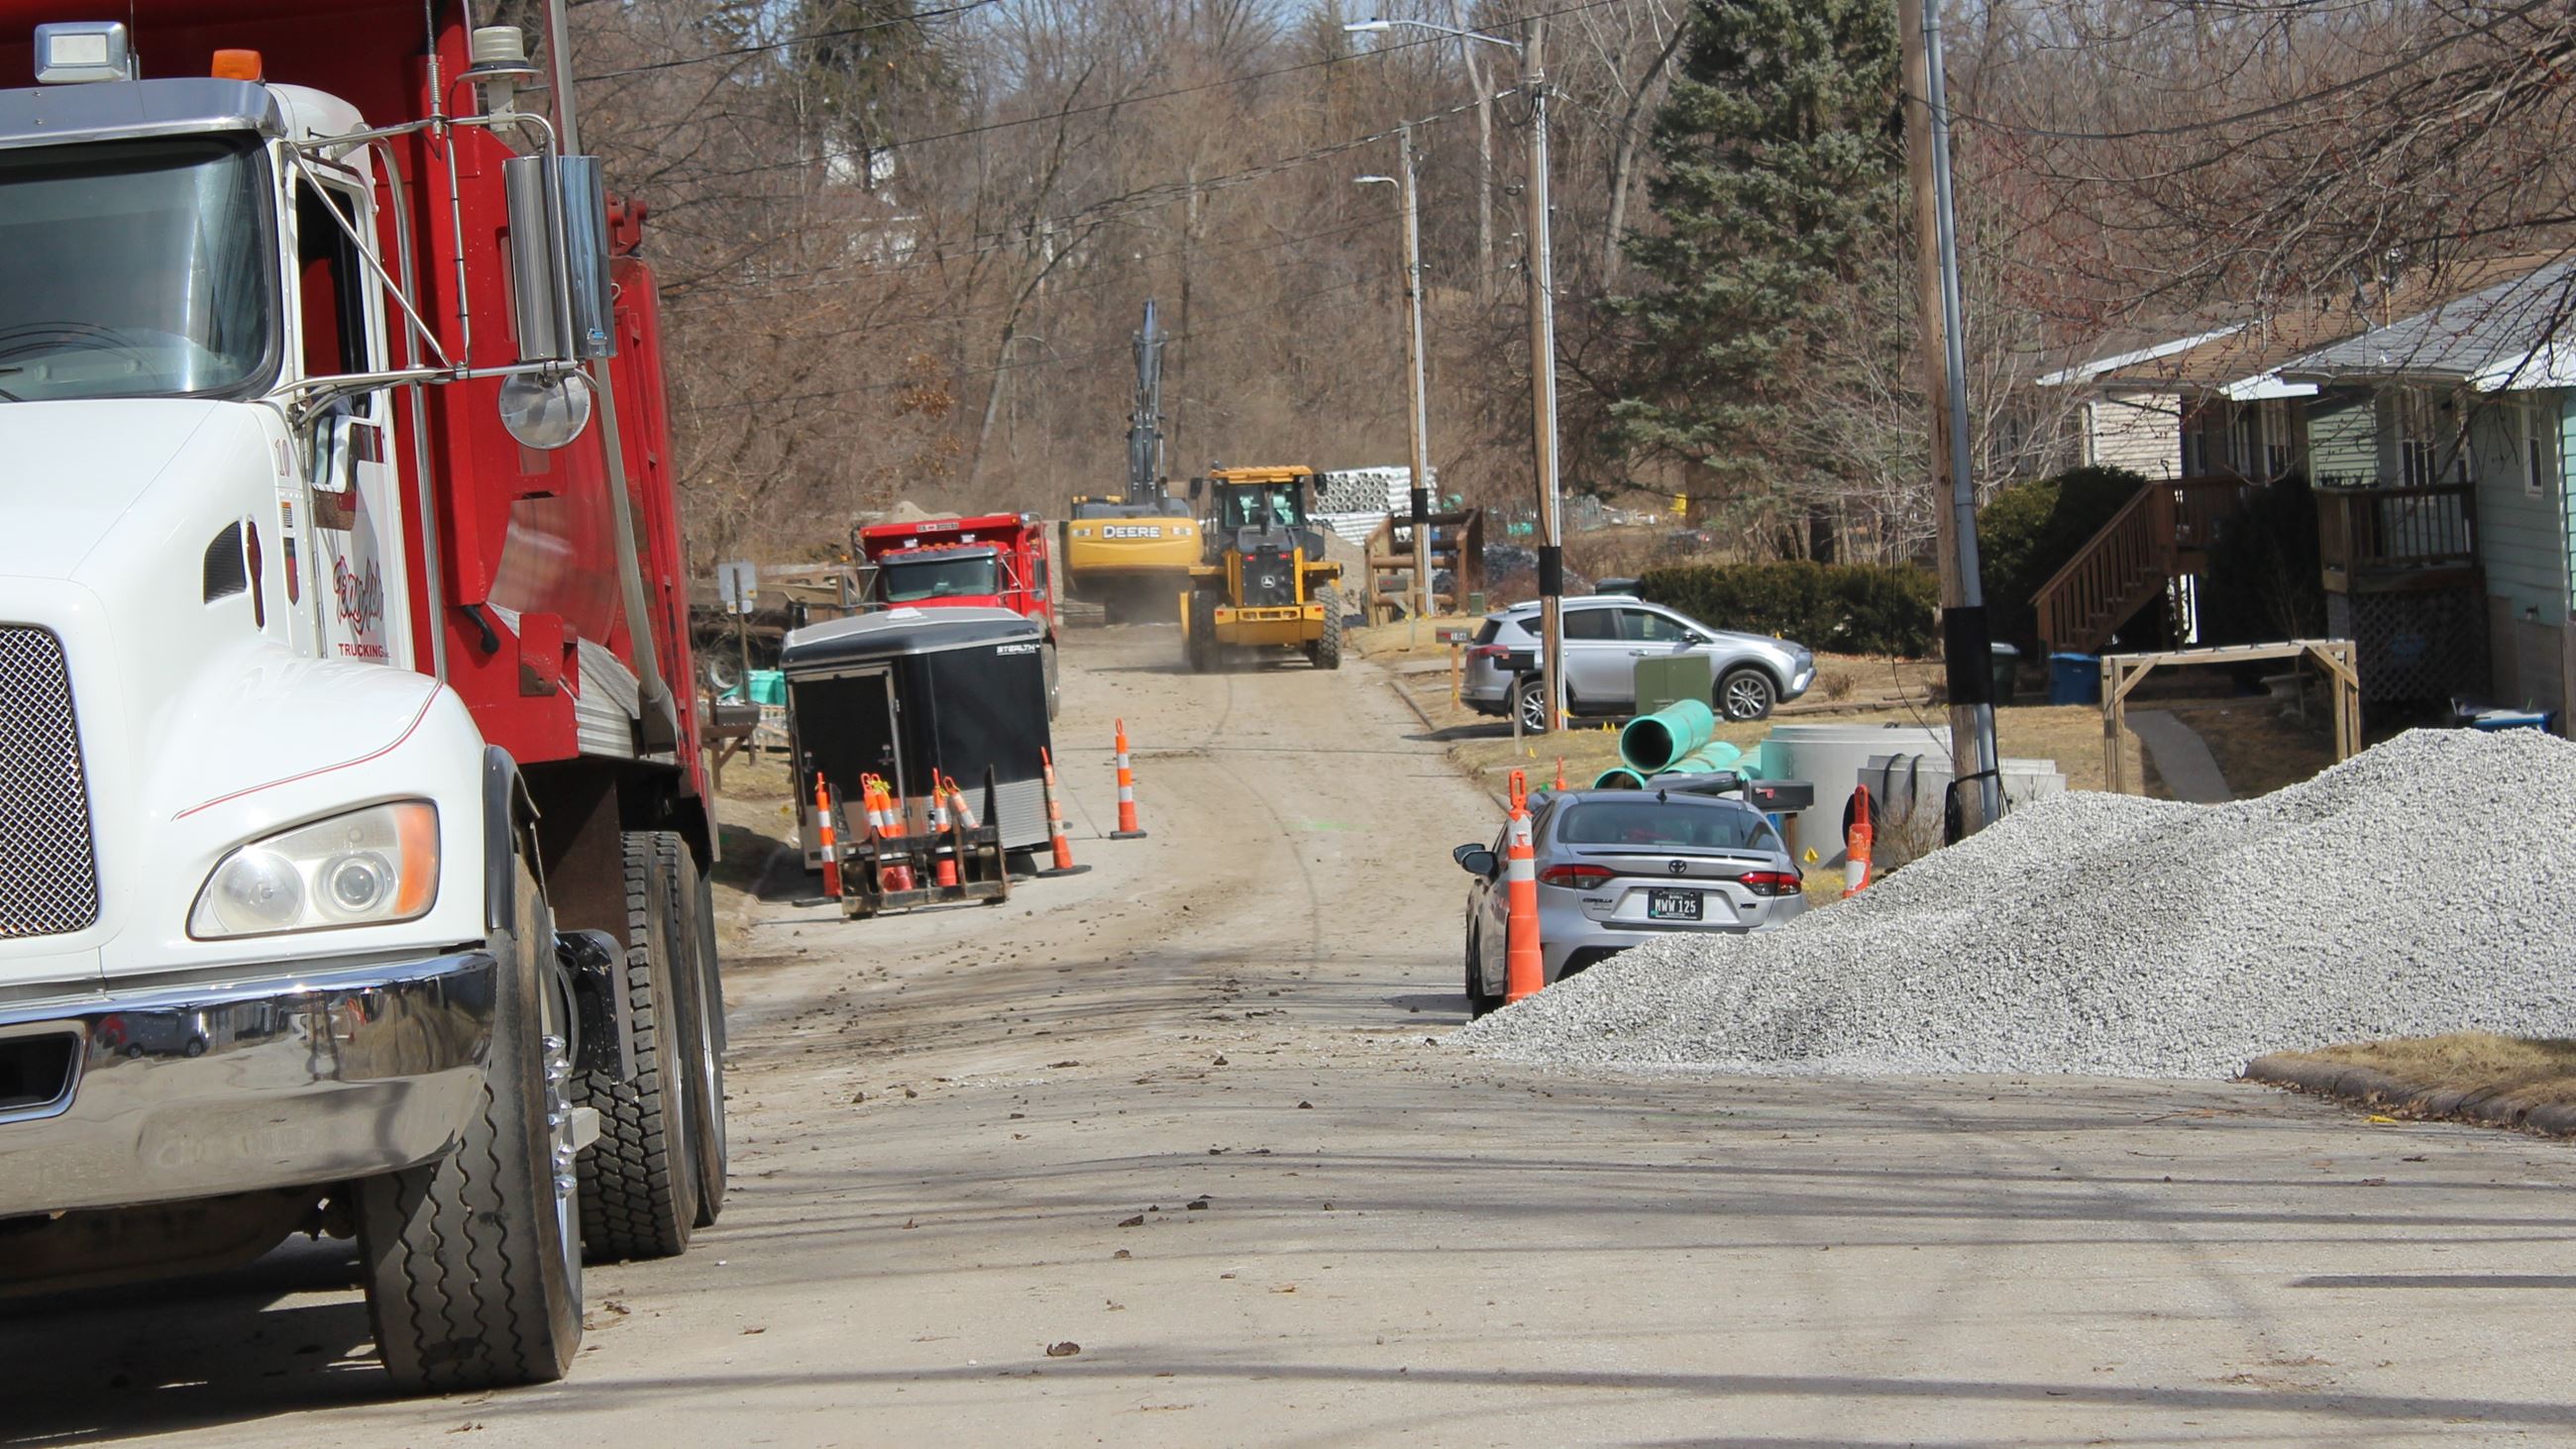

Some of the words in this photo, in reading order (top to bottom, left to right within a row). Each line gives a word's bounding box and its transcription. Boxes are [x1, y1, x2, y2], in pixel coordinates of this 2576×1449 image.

[1103, 525, 1160, 538] DEERE
[338, 644, 384, 658] TRUCKING
[1655, 898, 1675, 912] MWW
[1678, 899, 1696, 913] 125
